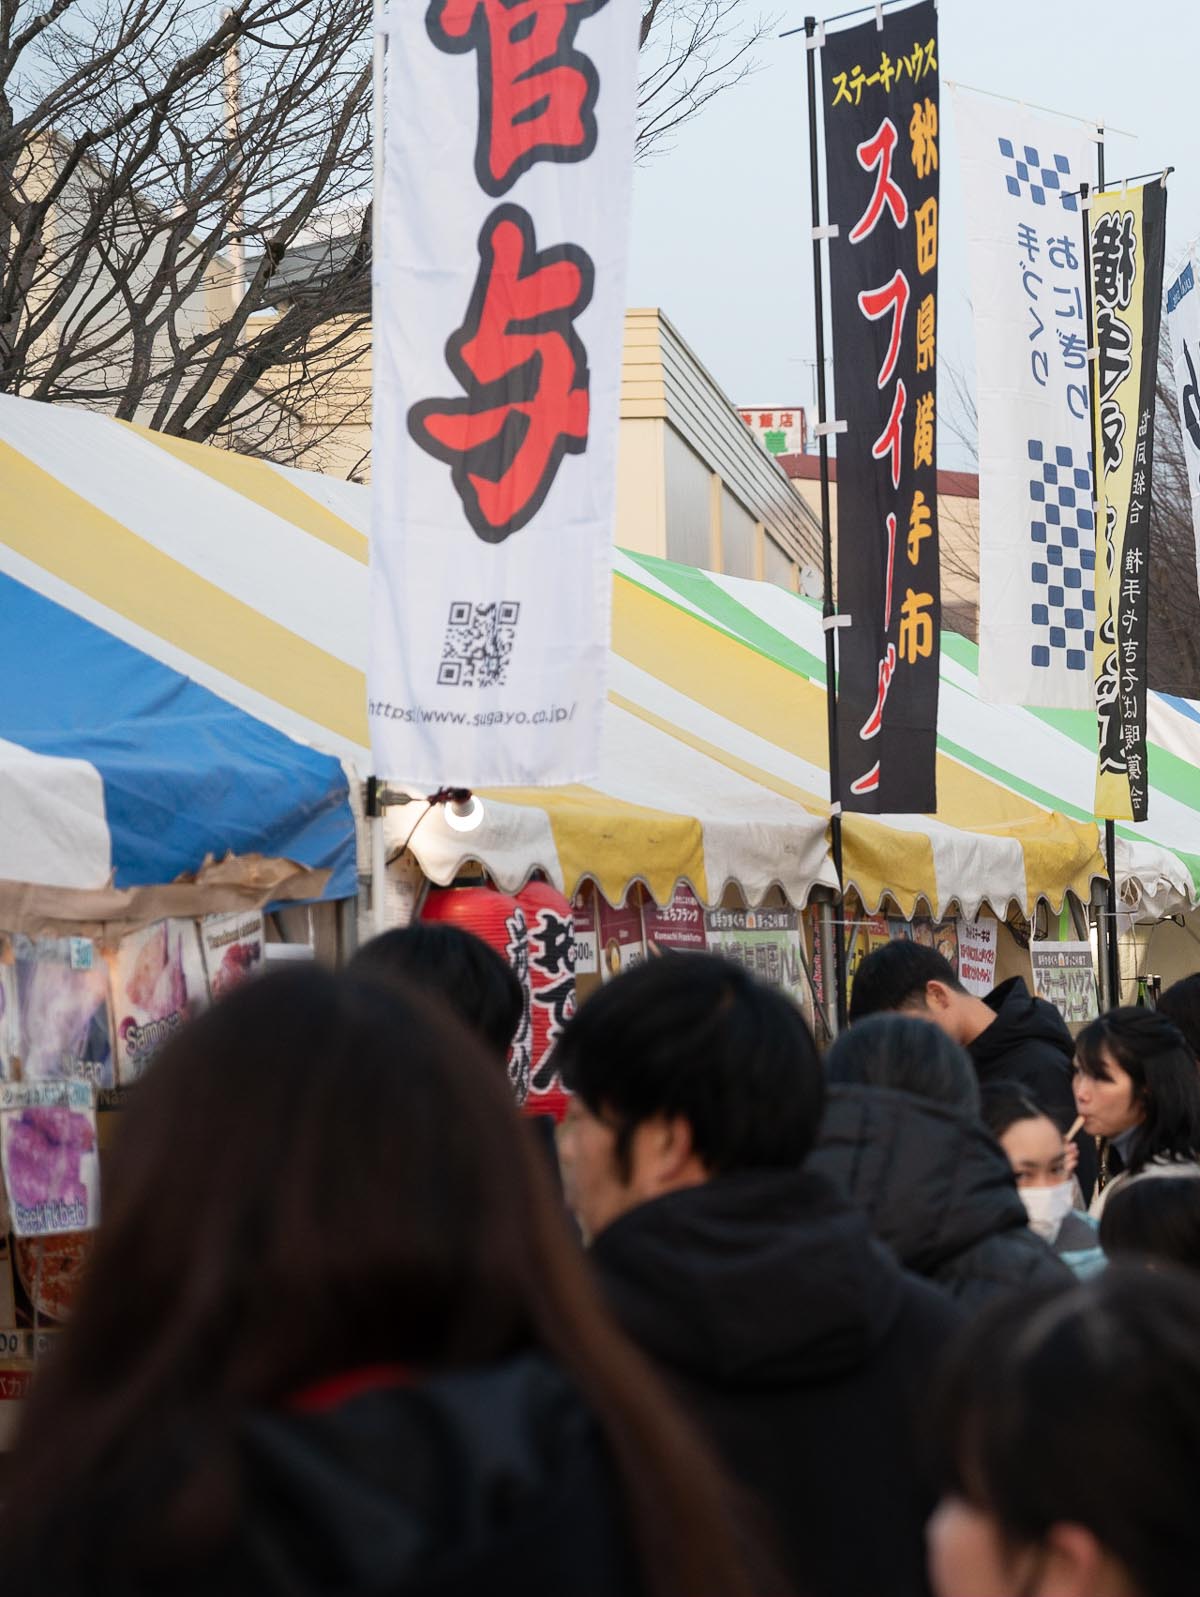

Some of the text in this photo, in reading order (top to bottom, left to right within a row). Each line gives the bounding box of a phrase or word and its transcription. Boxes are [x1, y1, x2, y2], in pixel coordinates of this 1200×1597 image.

[831, 38, 937, 106] ステーキハウス
[900, 97, 938, 664] 秋田県横手市
